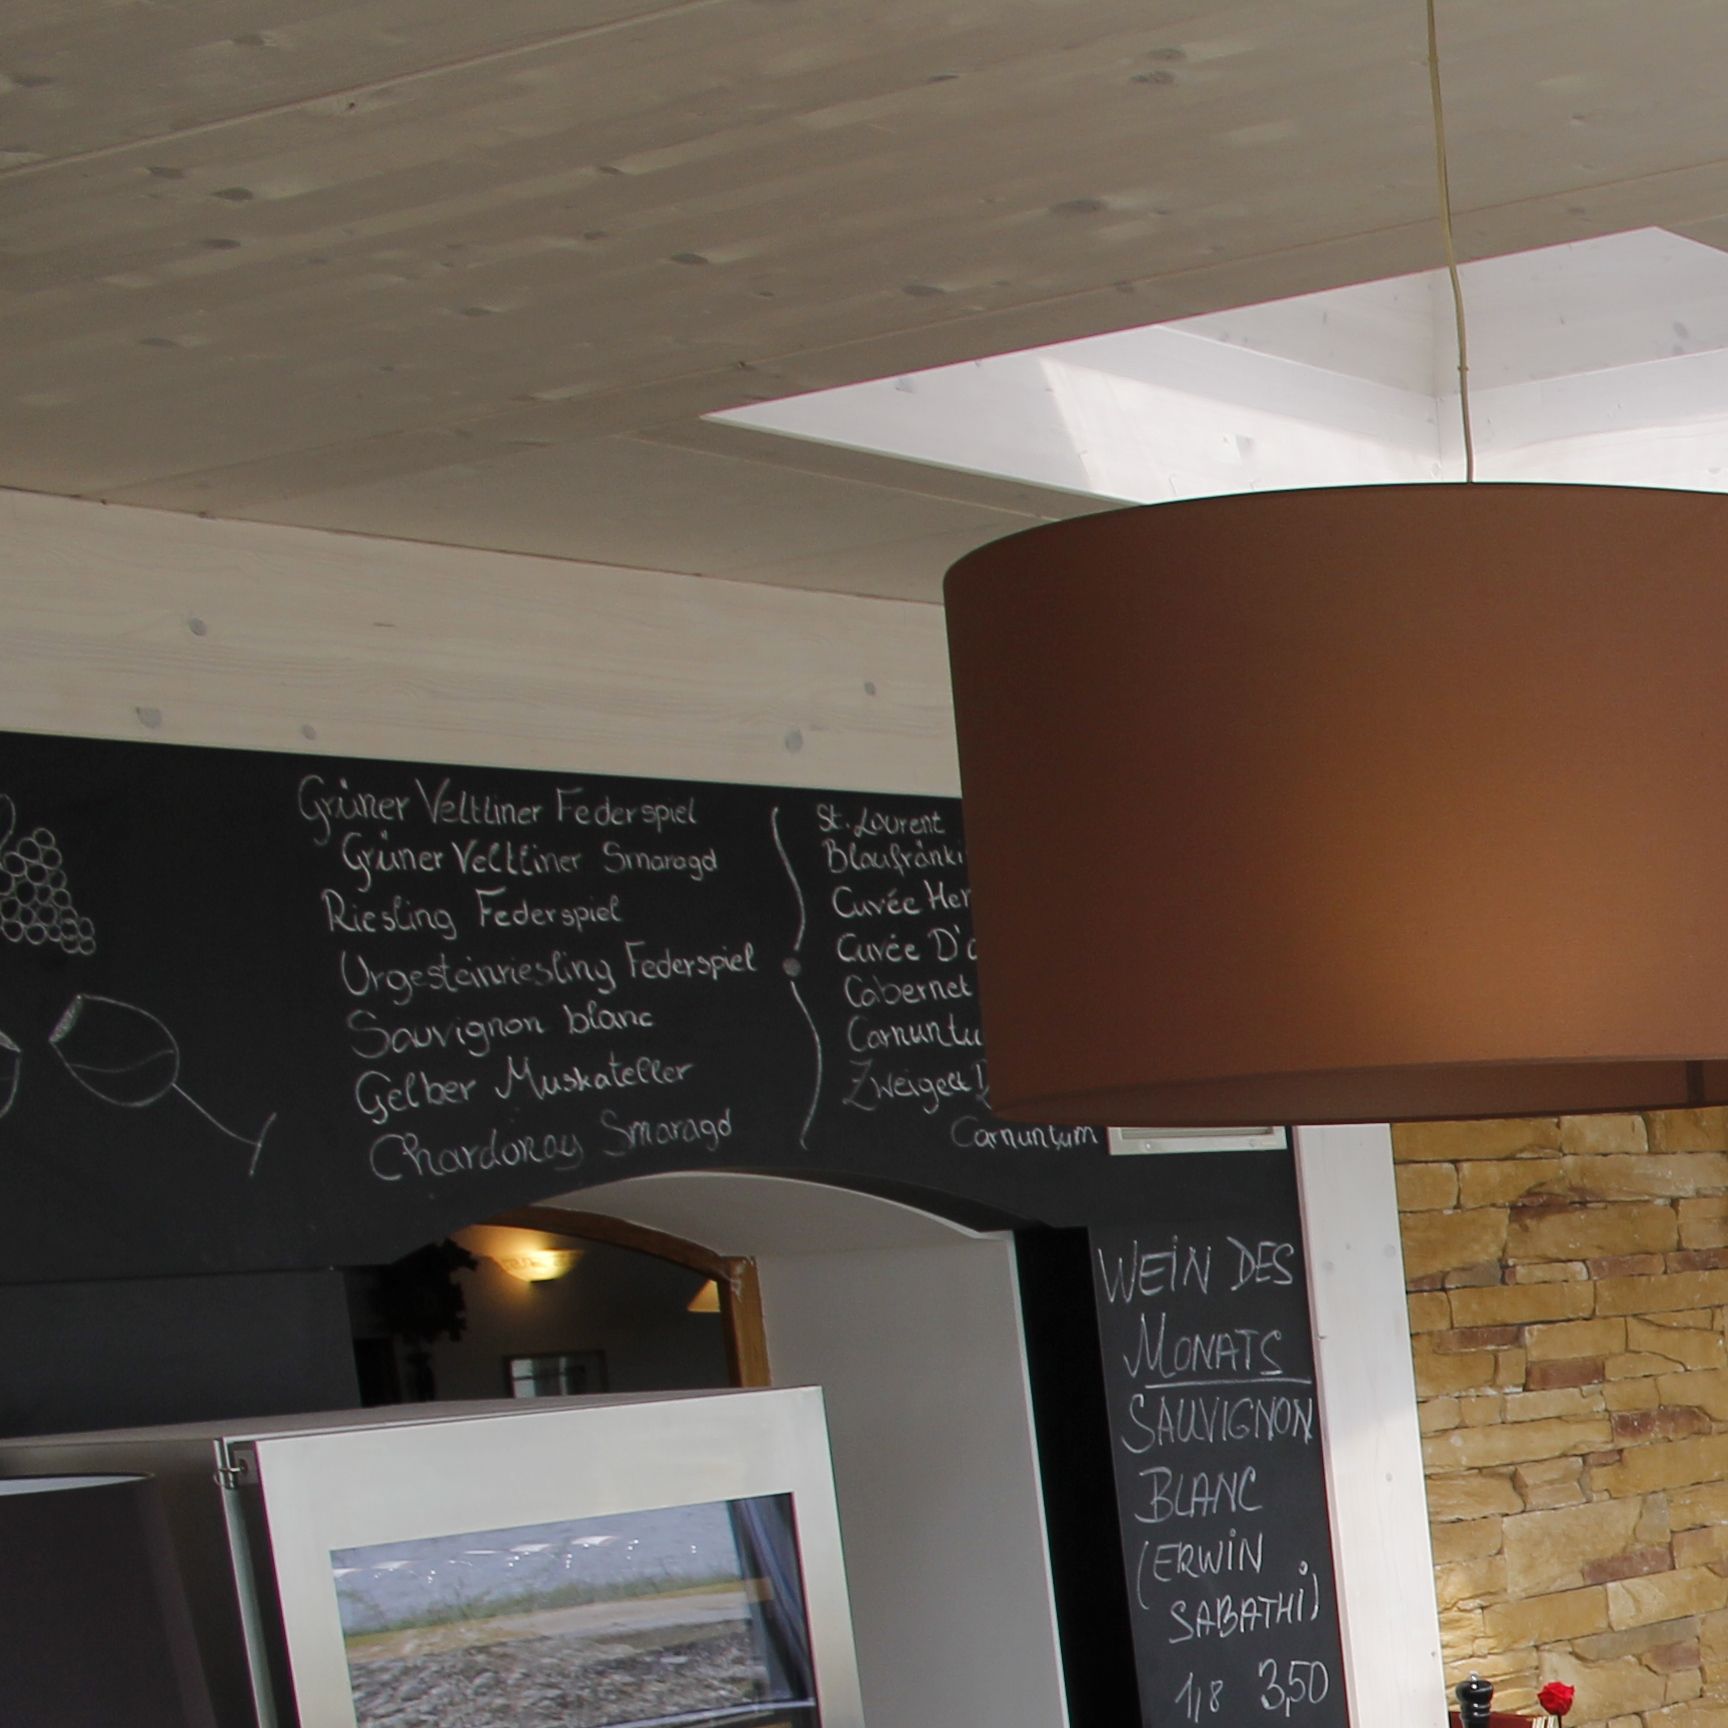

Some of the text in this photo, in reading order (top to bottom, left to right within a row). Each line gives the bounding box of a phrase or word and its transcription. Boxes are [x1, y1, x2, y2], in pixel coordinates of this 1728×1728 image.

[298, 775, 699, 846] Grüner Veltliner Federspiel
[341, 830, 719, 892] Grüner Veltliner Smaragd
[320, 888, 623, 941] Riesling Federspiel
[340, 941, 758, 1006] Urgesteinriesling Federspiel
[844, 973, 974, 1009] Cabernet
[345, 1001, 656, 1059] Sauvignon blanc
[355, 1050, 695, 1125] Gelber Muskateller
[842, 1058, 972, 1114] Zweigelt
[600, 1107, 733, 1157] Smaragd
[950, 1115, 1099, 1151] Carnuntum
[1227, 1236, 1294, 1291] DES
[1123, 1311, 1283, 1379] MONATS
[1120, 1393, 1313, 1453] SAUVIGNON
[1134, 1465, 1263, 1523] BLANC
[1258, 1658, 1330, 1718] 3,50
